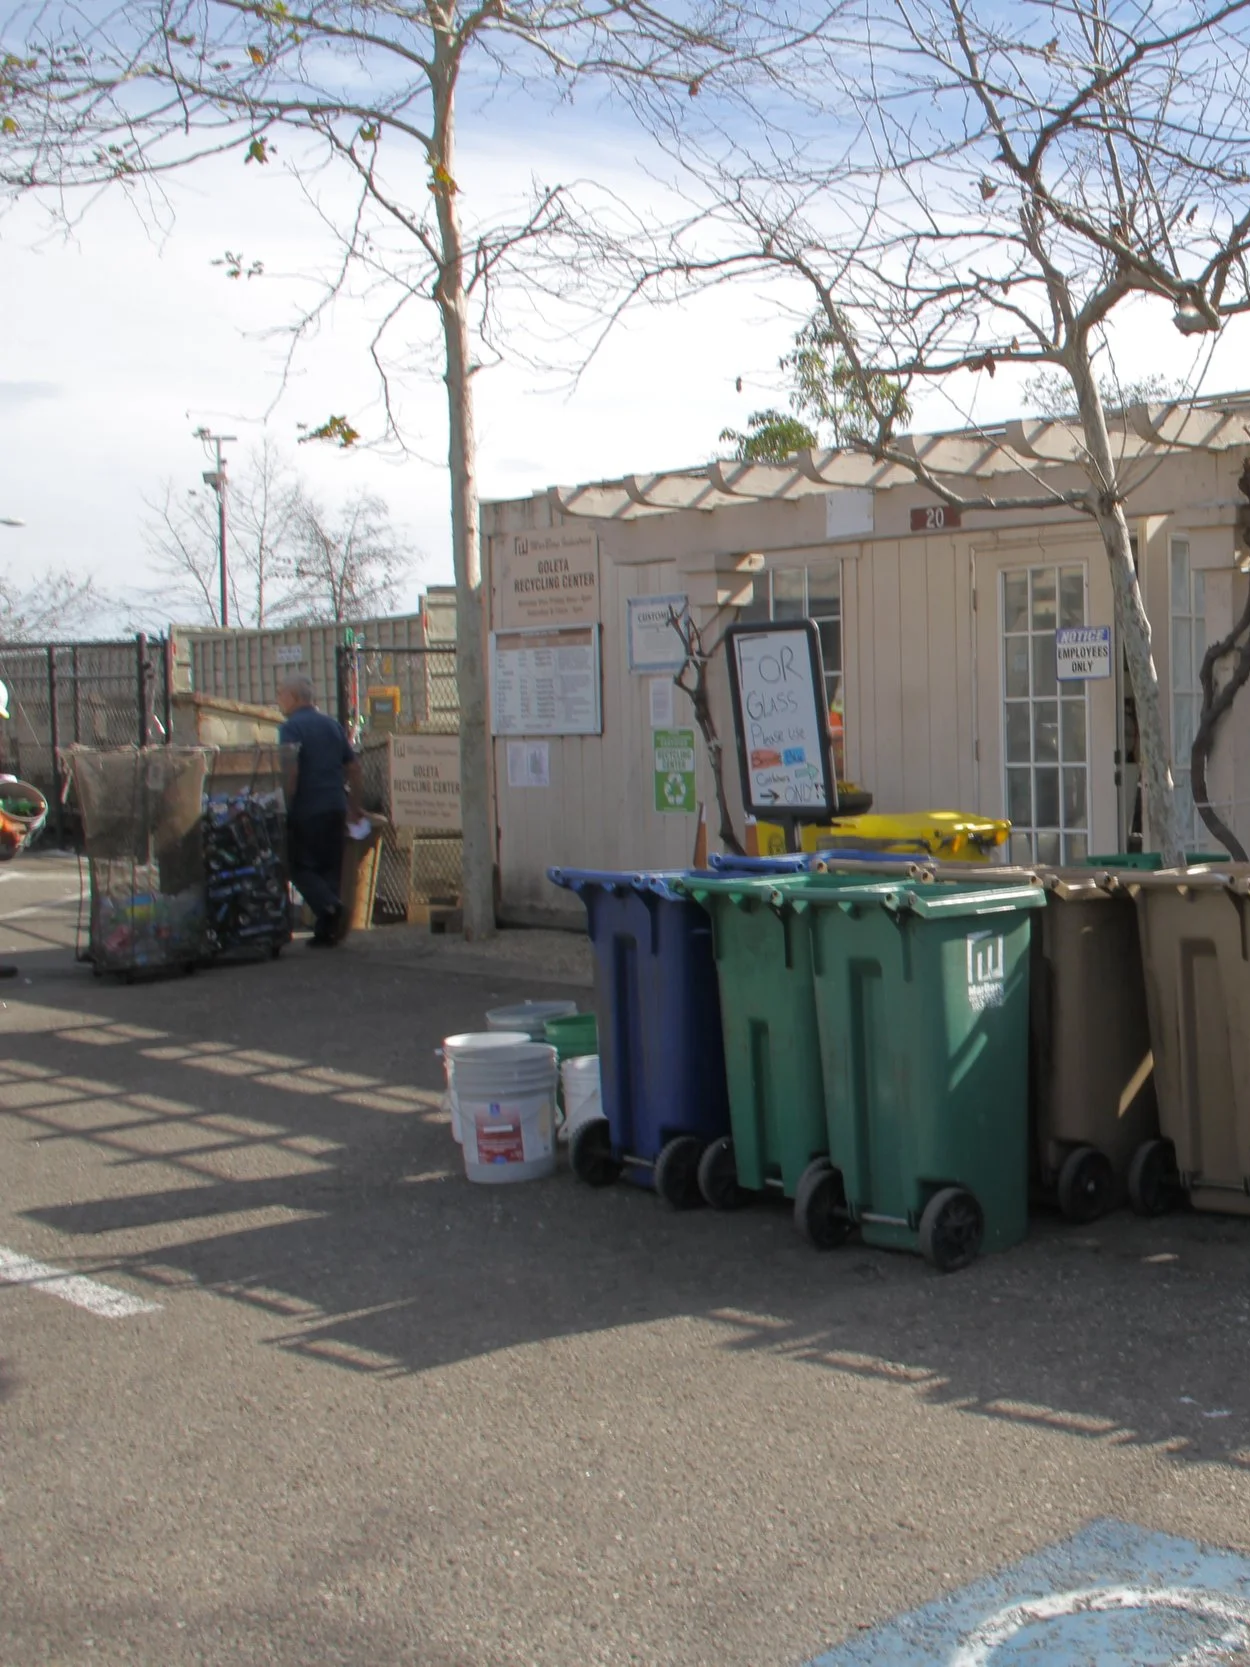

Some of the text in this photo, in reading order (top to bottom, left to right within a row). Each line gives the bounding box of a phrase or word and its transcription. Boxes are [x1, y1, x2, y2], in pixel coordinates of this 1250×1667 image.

[926, 507, 944, 528] 20
[538, 558, 570, 574] GOLETA
[514, 572, 595, 592] RECYCLING CENTER
[1060, 628, 1103, 643] NOTICE
[1058, 645, 1108, 660] EMPLOYEES
[1072, 660, 1093, 673] ONLY
[746, 690, 799, 721] GLASS
[658, 749, 692, 761] RECYCLING
[413, 765, 440, 778] GOLETA
[662, 760, 687, 770] CENTER
[394, 779, 460, 795] RECYCLING CENTER
